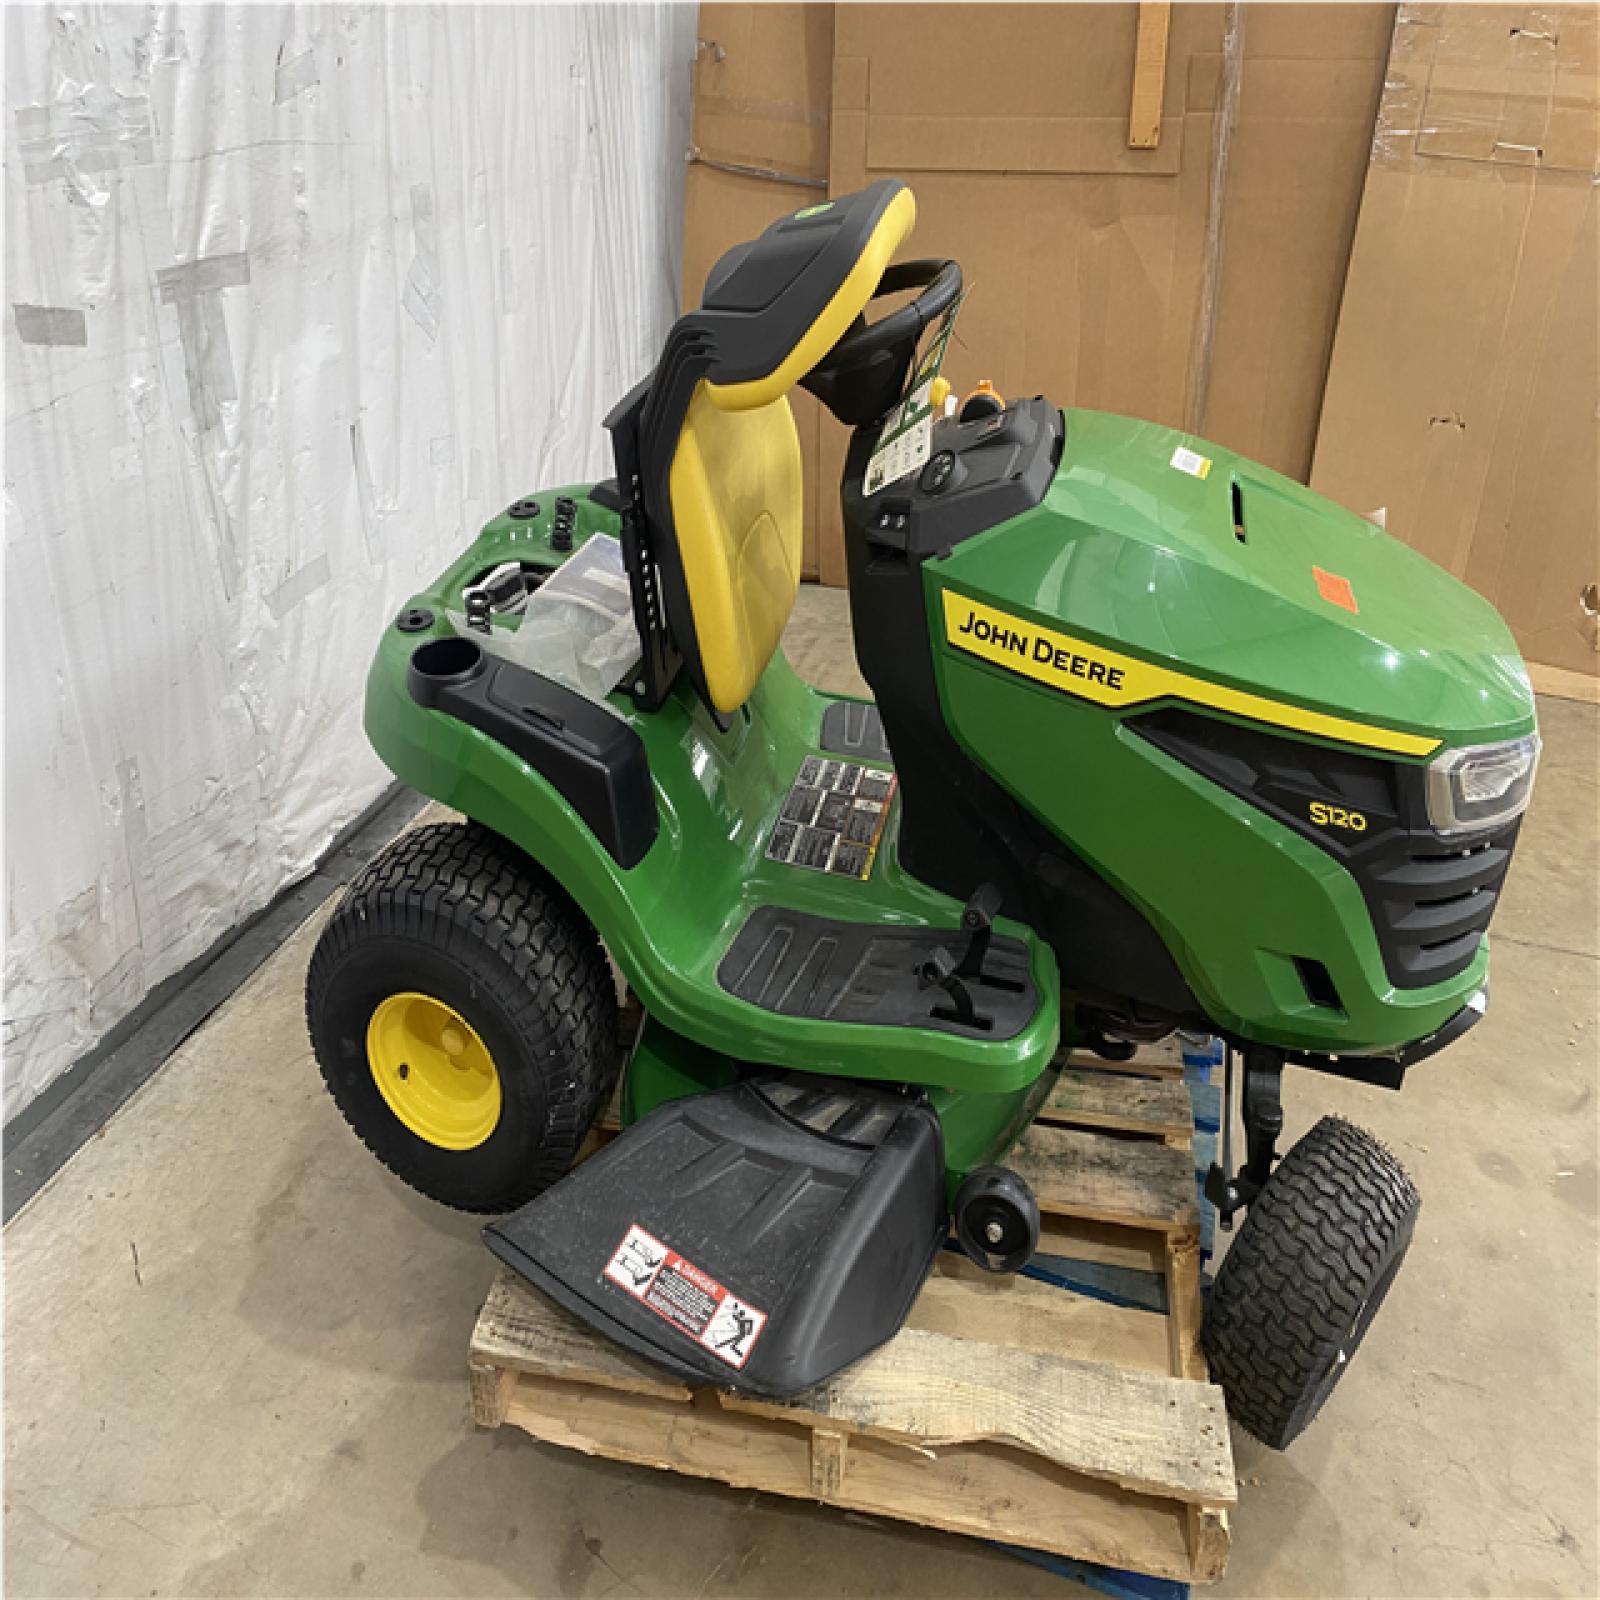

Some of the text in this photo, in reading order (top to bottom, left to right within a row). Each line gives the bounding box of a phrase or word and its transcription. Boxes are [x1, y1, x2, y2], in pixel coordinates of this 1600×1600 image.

[959, 611, 1125, 690] JOHN DEERE
[1309, 801, 1367, 831] S120
